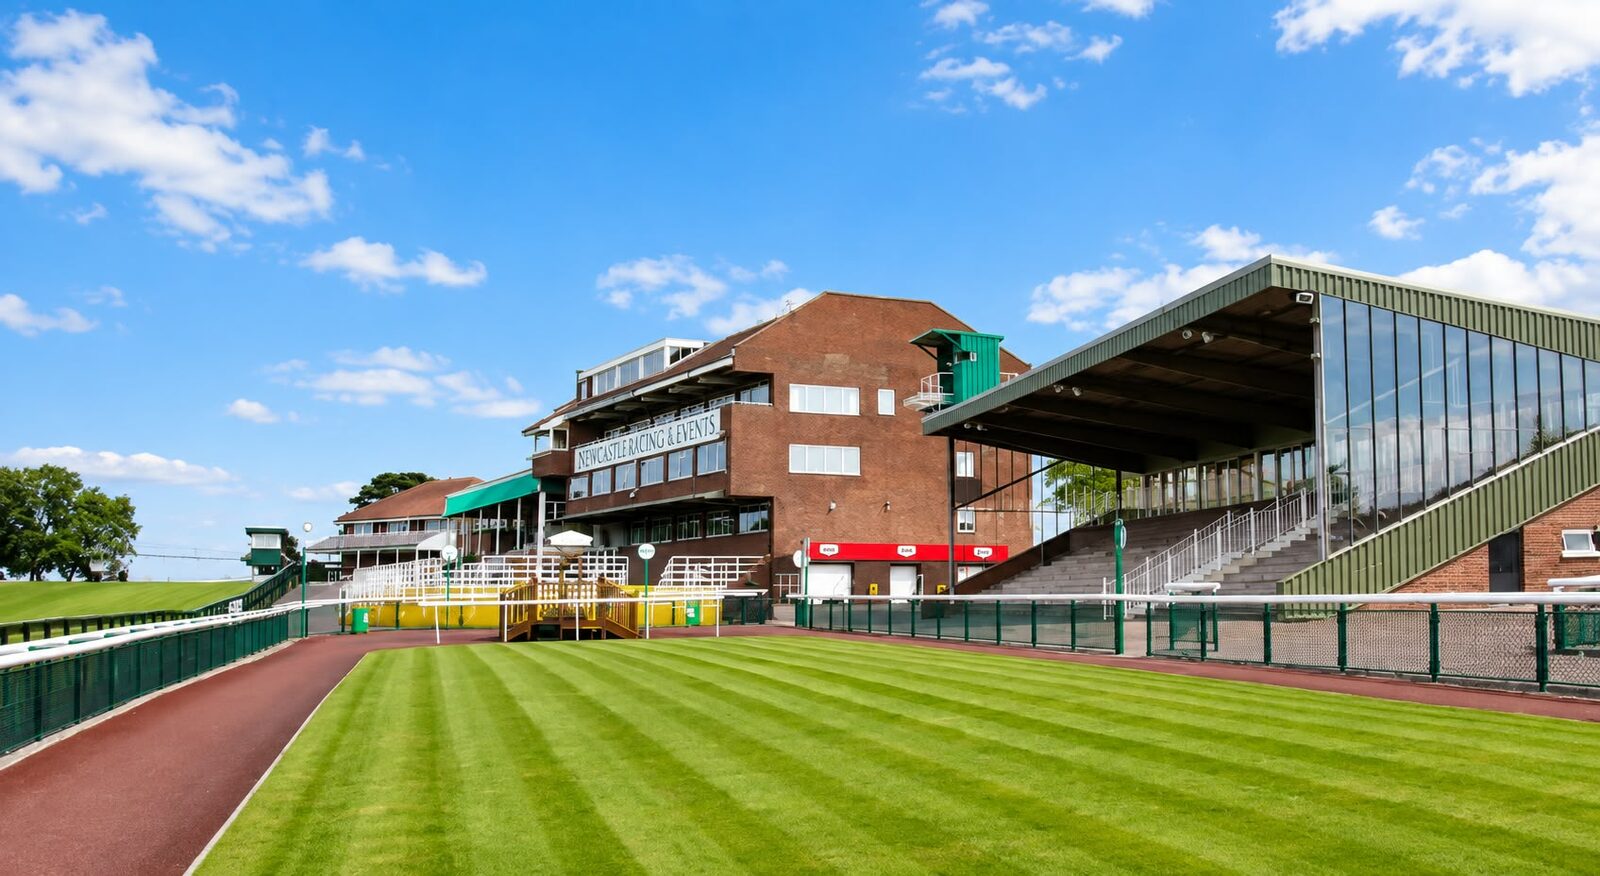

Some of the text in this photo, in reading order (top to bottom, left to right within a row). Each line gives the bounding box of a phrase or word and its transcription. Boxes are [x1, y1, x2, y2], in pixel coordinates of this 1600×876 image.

[578, 414, 715, 470] NEWCASTLE RACING & EVENTS
